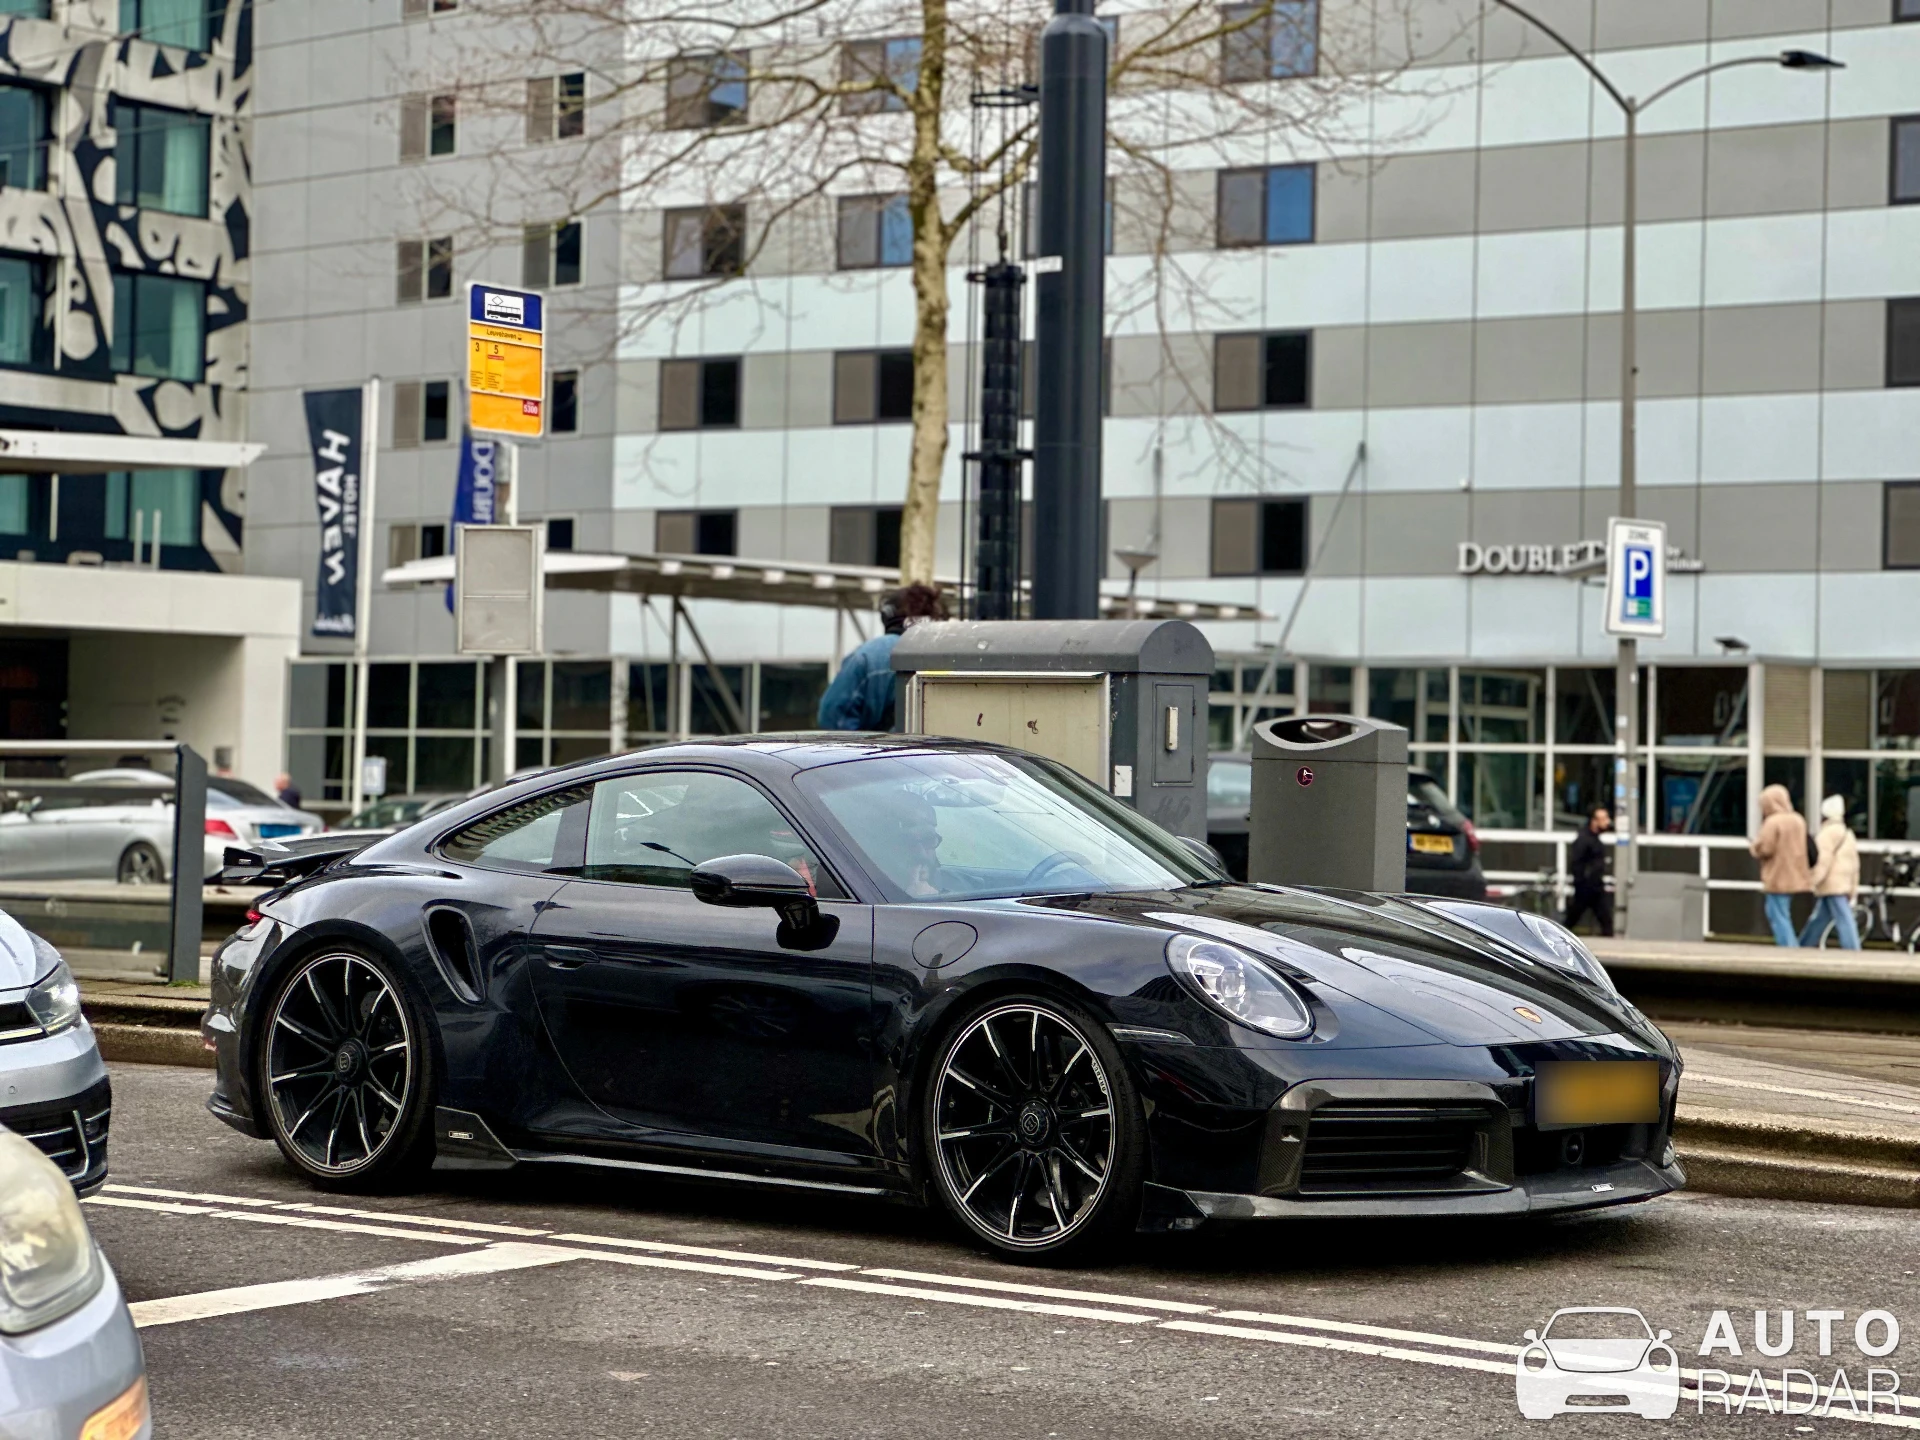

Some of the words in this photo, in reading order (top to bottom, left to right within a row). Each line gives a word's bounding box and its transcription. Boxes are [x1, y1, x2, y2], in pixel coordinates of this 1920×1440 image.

[475, 342, 480, 352] 3
[494, 344, 499, 354] 5
[1456, 540, 1607, 573] DOUBLET
[1628, 549, 1650, 597] P
